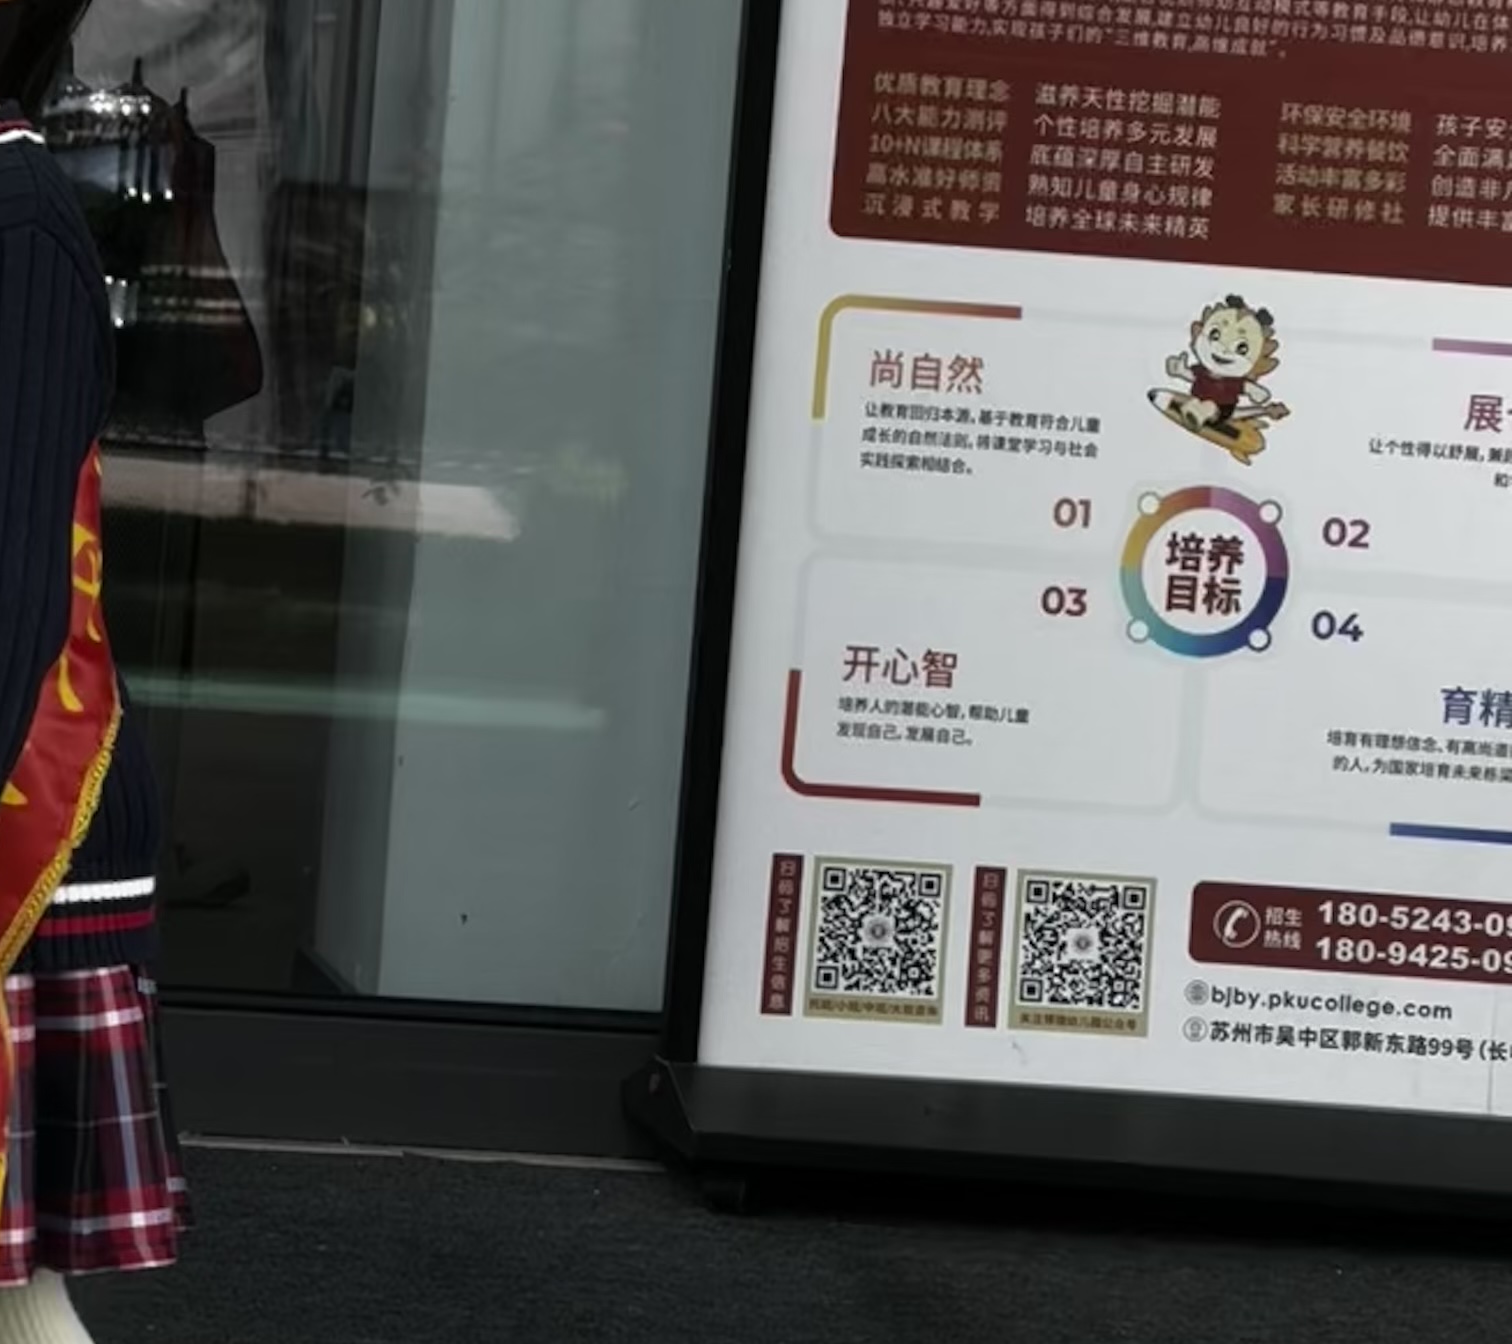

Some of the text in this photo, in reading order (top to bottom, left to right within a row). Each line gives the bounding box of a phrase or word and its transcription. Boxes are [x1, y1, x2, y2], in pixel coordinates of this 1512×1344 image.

[1033, 113, 1218, 149] 个性培养多元发展
[1436, 113, 1512, 141] 孩子安
[1432, 143, 1512, 172] 全面满
[1275, 162, 1407, 194] 活动丰富多彩
[1024, 205, 1210, 241] 培养全球未来精英
[869, 348, 984, 395] 尚自然
[1463, 394, 1512, 434] 展
[1053, 497, 1091, 529] 01
[1321, 516, 1371, 549] 02
[1165, 530, 1245, 576] 培养
[1041, 585, 1088, 617] 03
[1164, 574, 1242, 616] 目标
[1311, 609, 1365, 643] 04
[842, 644, 959, 690] 开心智
[1440, 686, 1512, 730] 育精
[1326, 729, 1512, 759] 培育有理想信念、有高尚道
[1265, 906, 1303, 928] 招生
[1262, 929, 1302, 951] 热线
[1211, 985, 1453, 1020] bjby.pkucollege.com
[1210, 1020, 1512, 1062] 苏州市吴中区郭新东路99号(长
